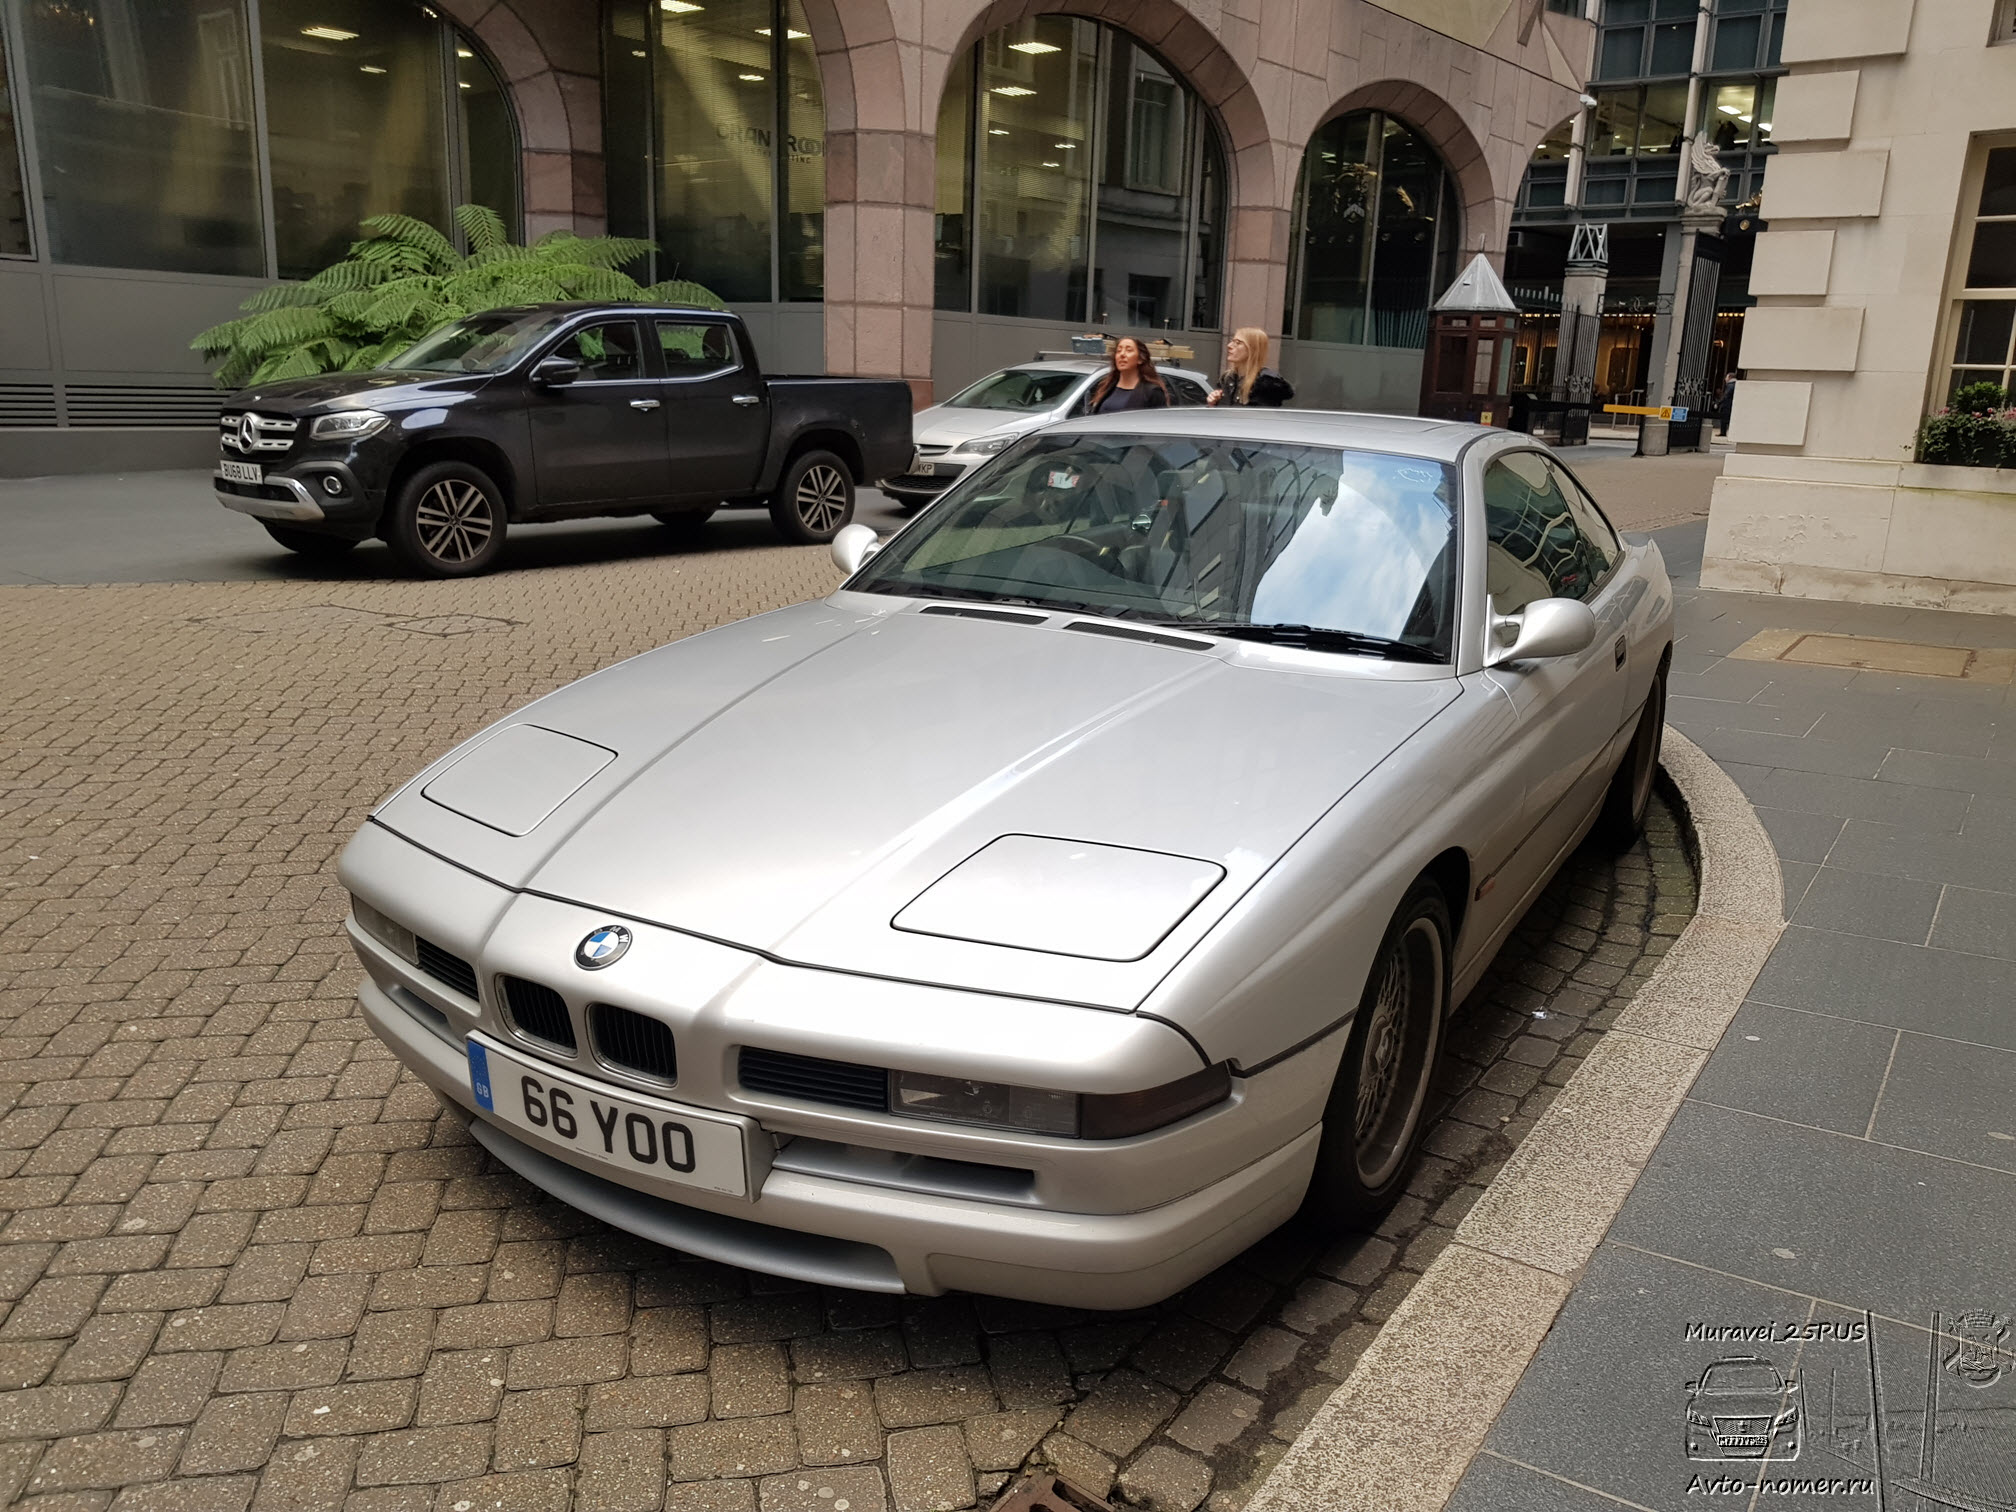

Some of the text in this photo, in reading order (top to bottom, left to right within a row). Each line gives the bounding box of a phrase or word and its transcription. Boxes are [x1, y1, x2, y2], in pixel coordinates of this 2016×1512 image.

[716, 126, 824, 157] CRANROO
[476, 1082, 489, 1098] GB
[521, 1075, 696, 1174] 66 YOO
